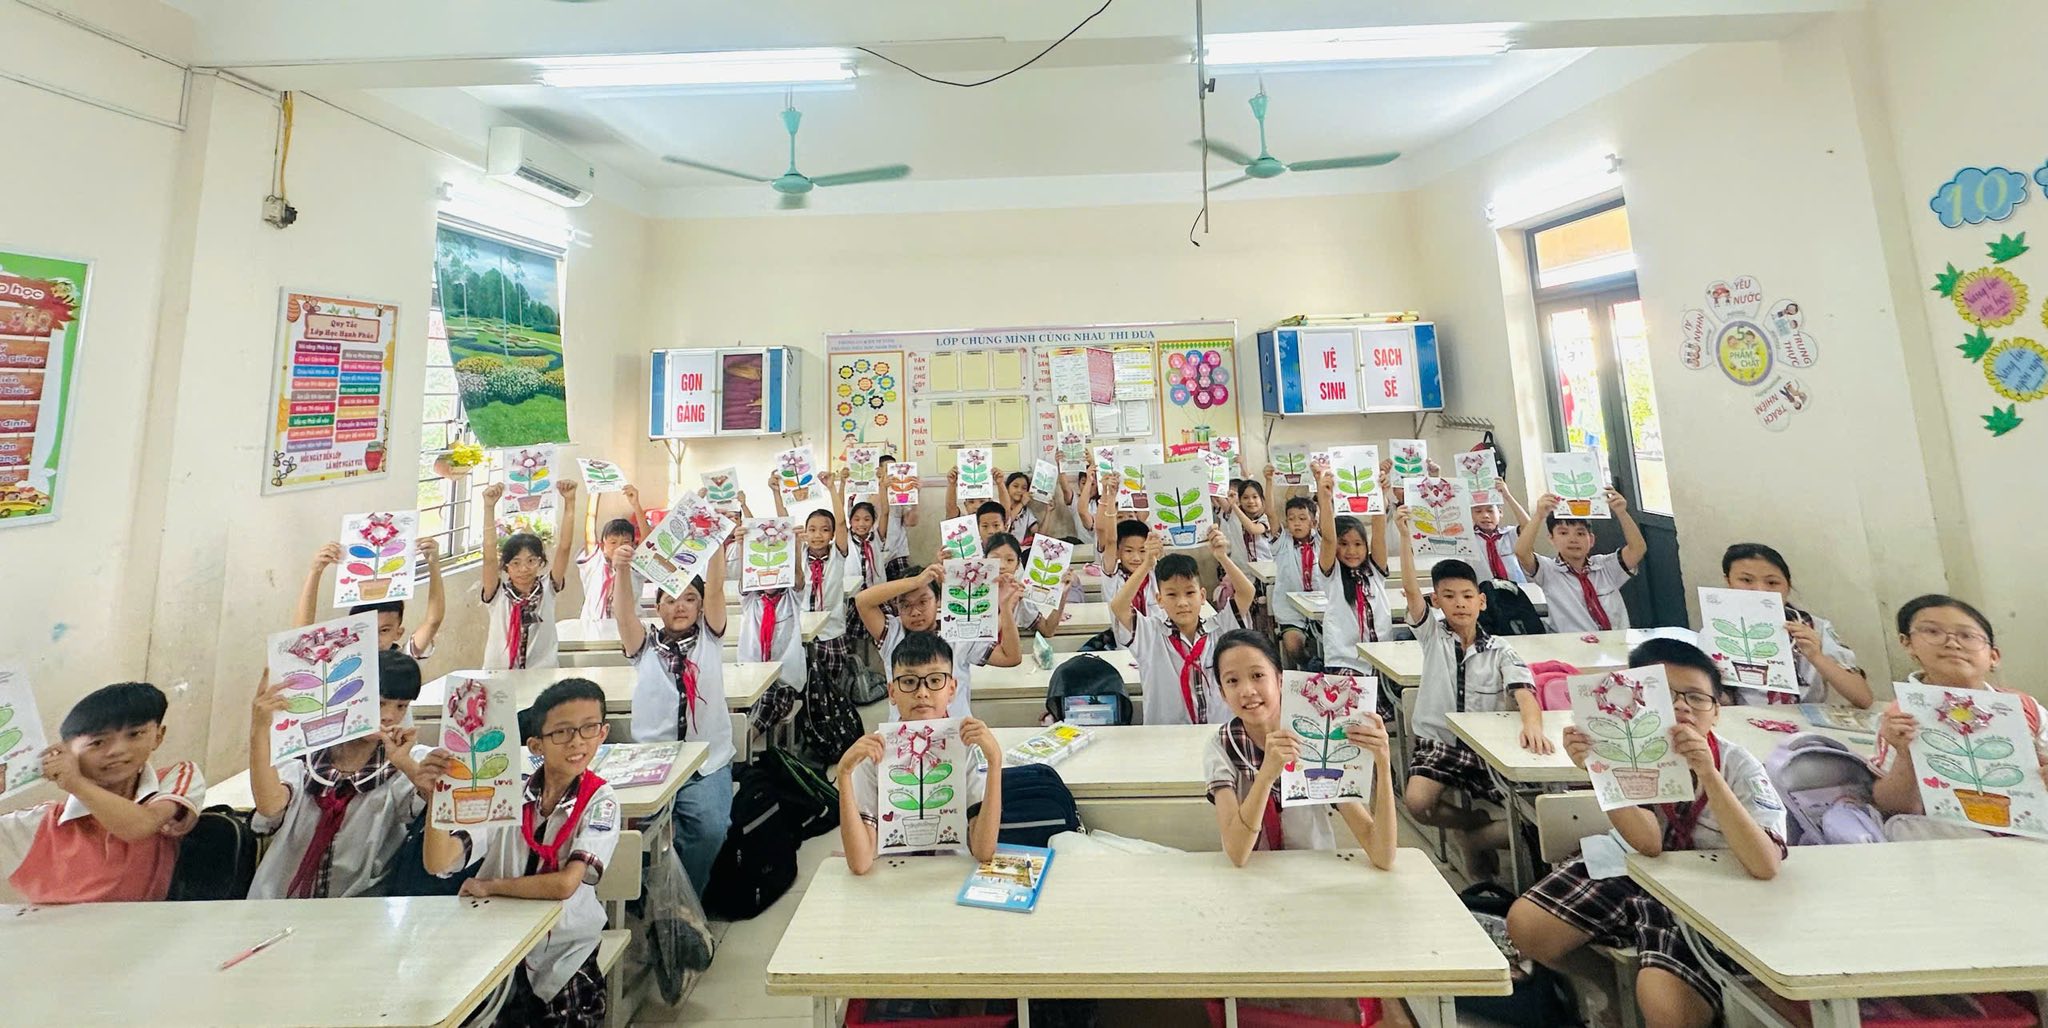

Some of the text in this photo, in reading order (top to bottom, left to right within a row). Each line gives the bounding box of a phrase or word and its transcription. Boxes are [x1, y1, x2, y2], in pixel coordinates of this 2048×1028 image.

[1946, 173, 2008, 223] 10
[1734, 279, 1751, 290] YÊU
[1733, 292, 1761, 305] NƯỚC
[936, 330, 1155, 346] LỚP CHÚNG MÌNH CÙNG NHAU THI ĐUA
[1793, 331, 1812, 365] TRUNG
[1323, 347, 1337, 372] VỆ
[1373, 348, 1403, 371] SẠCH
[681, 373, 703, 396] GỌN
[1319, 382, 1346, 400] SINH
[1383, 376, 1398, 398] SẼ
[676, 400, 705, 423] GÀNG
